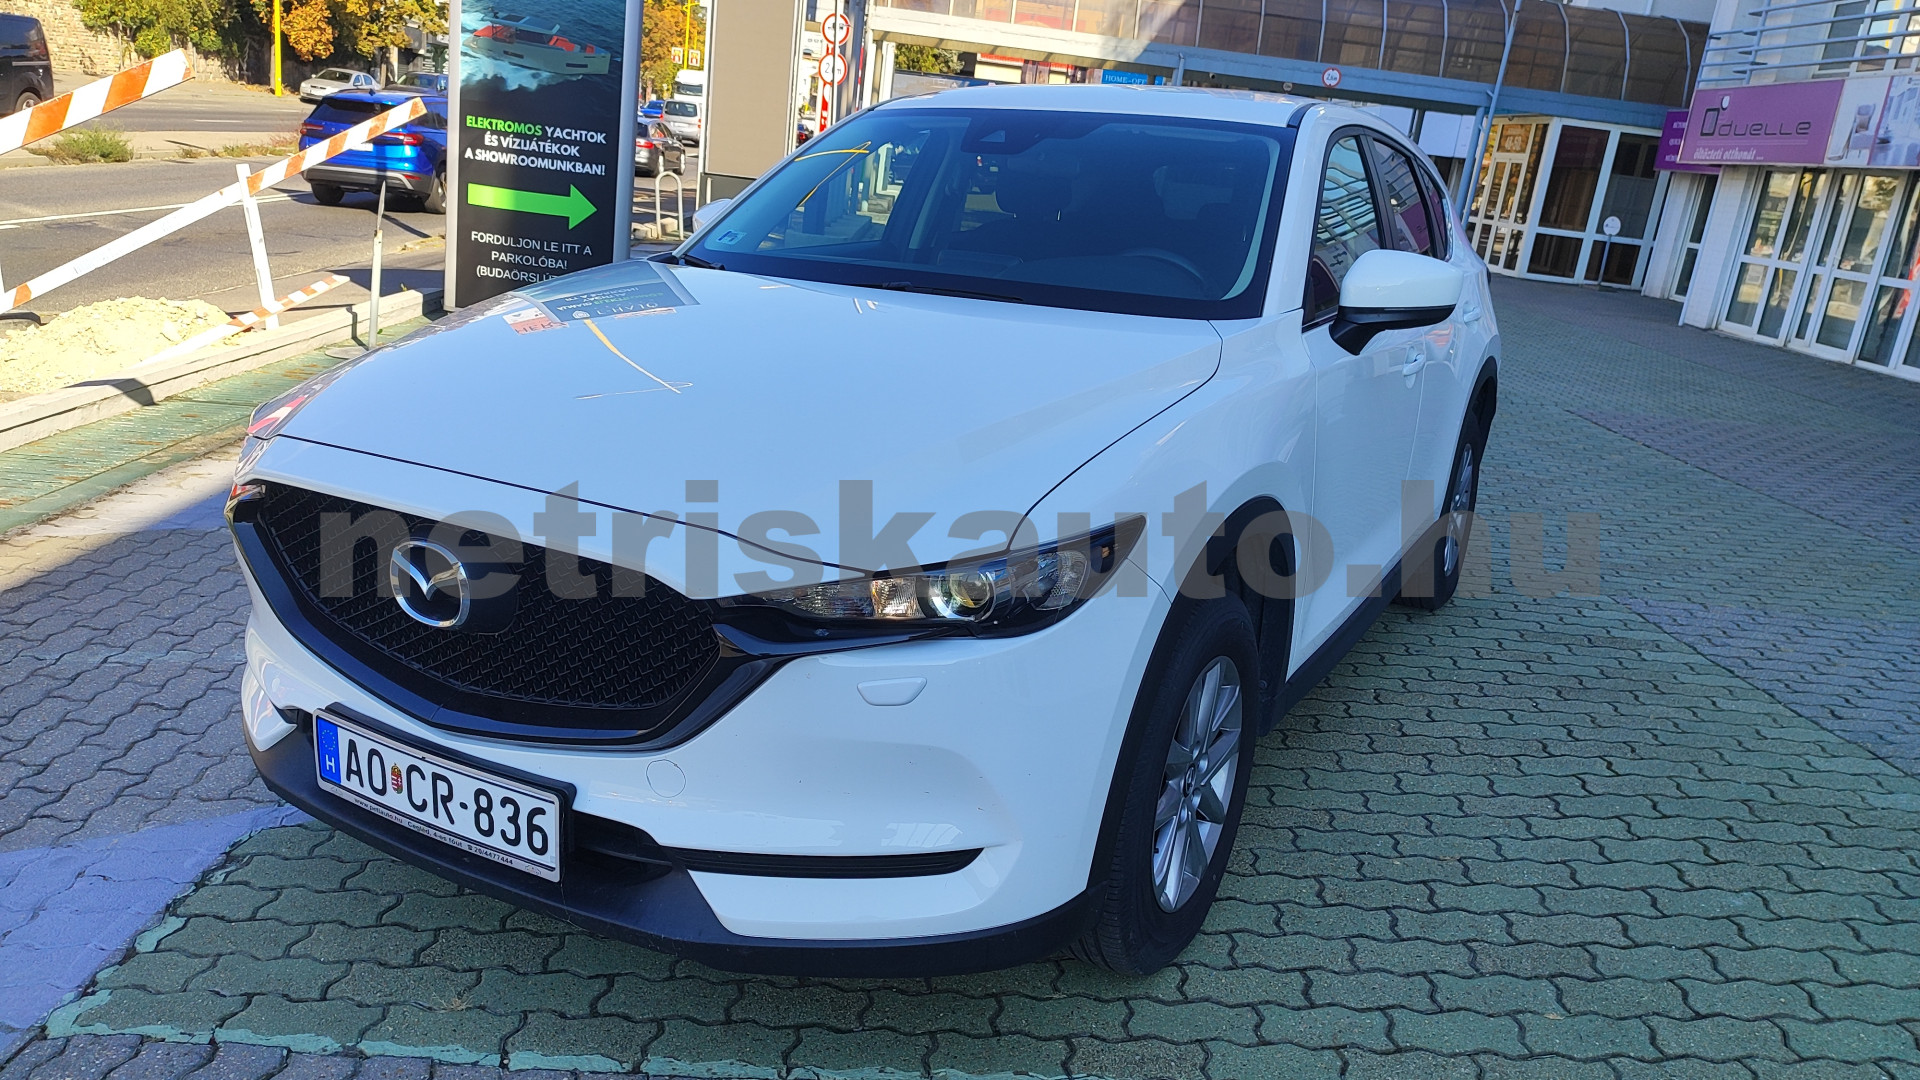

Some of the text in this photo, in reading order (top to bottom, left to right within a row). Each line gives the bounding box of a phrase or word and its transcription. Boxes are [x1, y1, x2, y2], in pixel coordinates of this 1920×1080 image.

[466, 115, 607, 145] ELEKTROMOS YACHTOK
[484, 132, 581, 158] ÉS VÍZIJÁTÉKOK
[464, 147, 606, 176] A SHOWROOMUNKBAN!
[471, 230, 593, 256] FORDULJON LE ITT A
[491, 251, 568, 270] PARKOLÓBA!
[325, 753, 336, 774] H
[406, 764, 549, 856] CR-836
